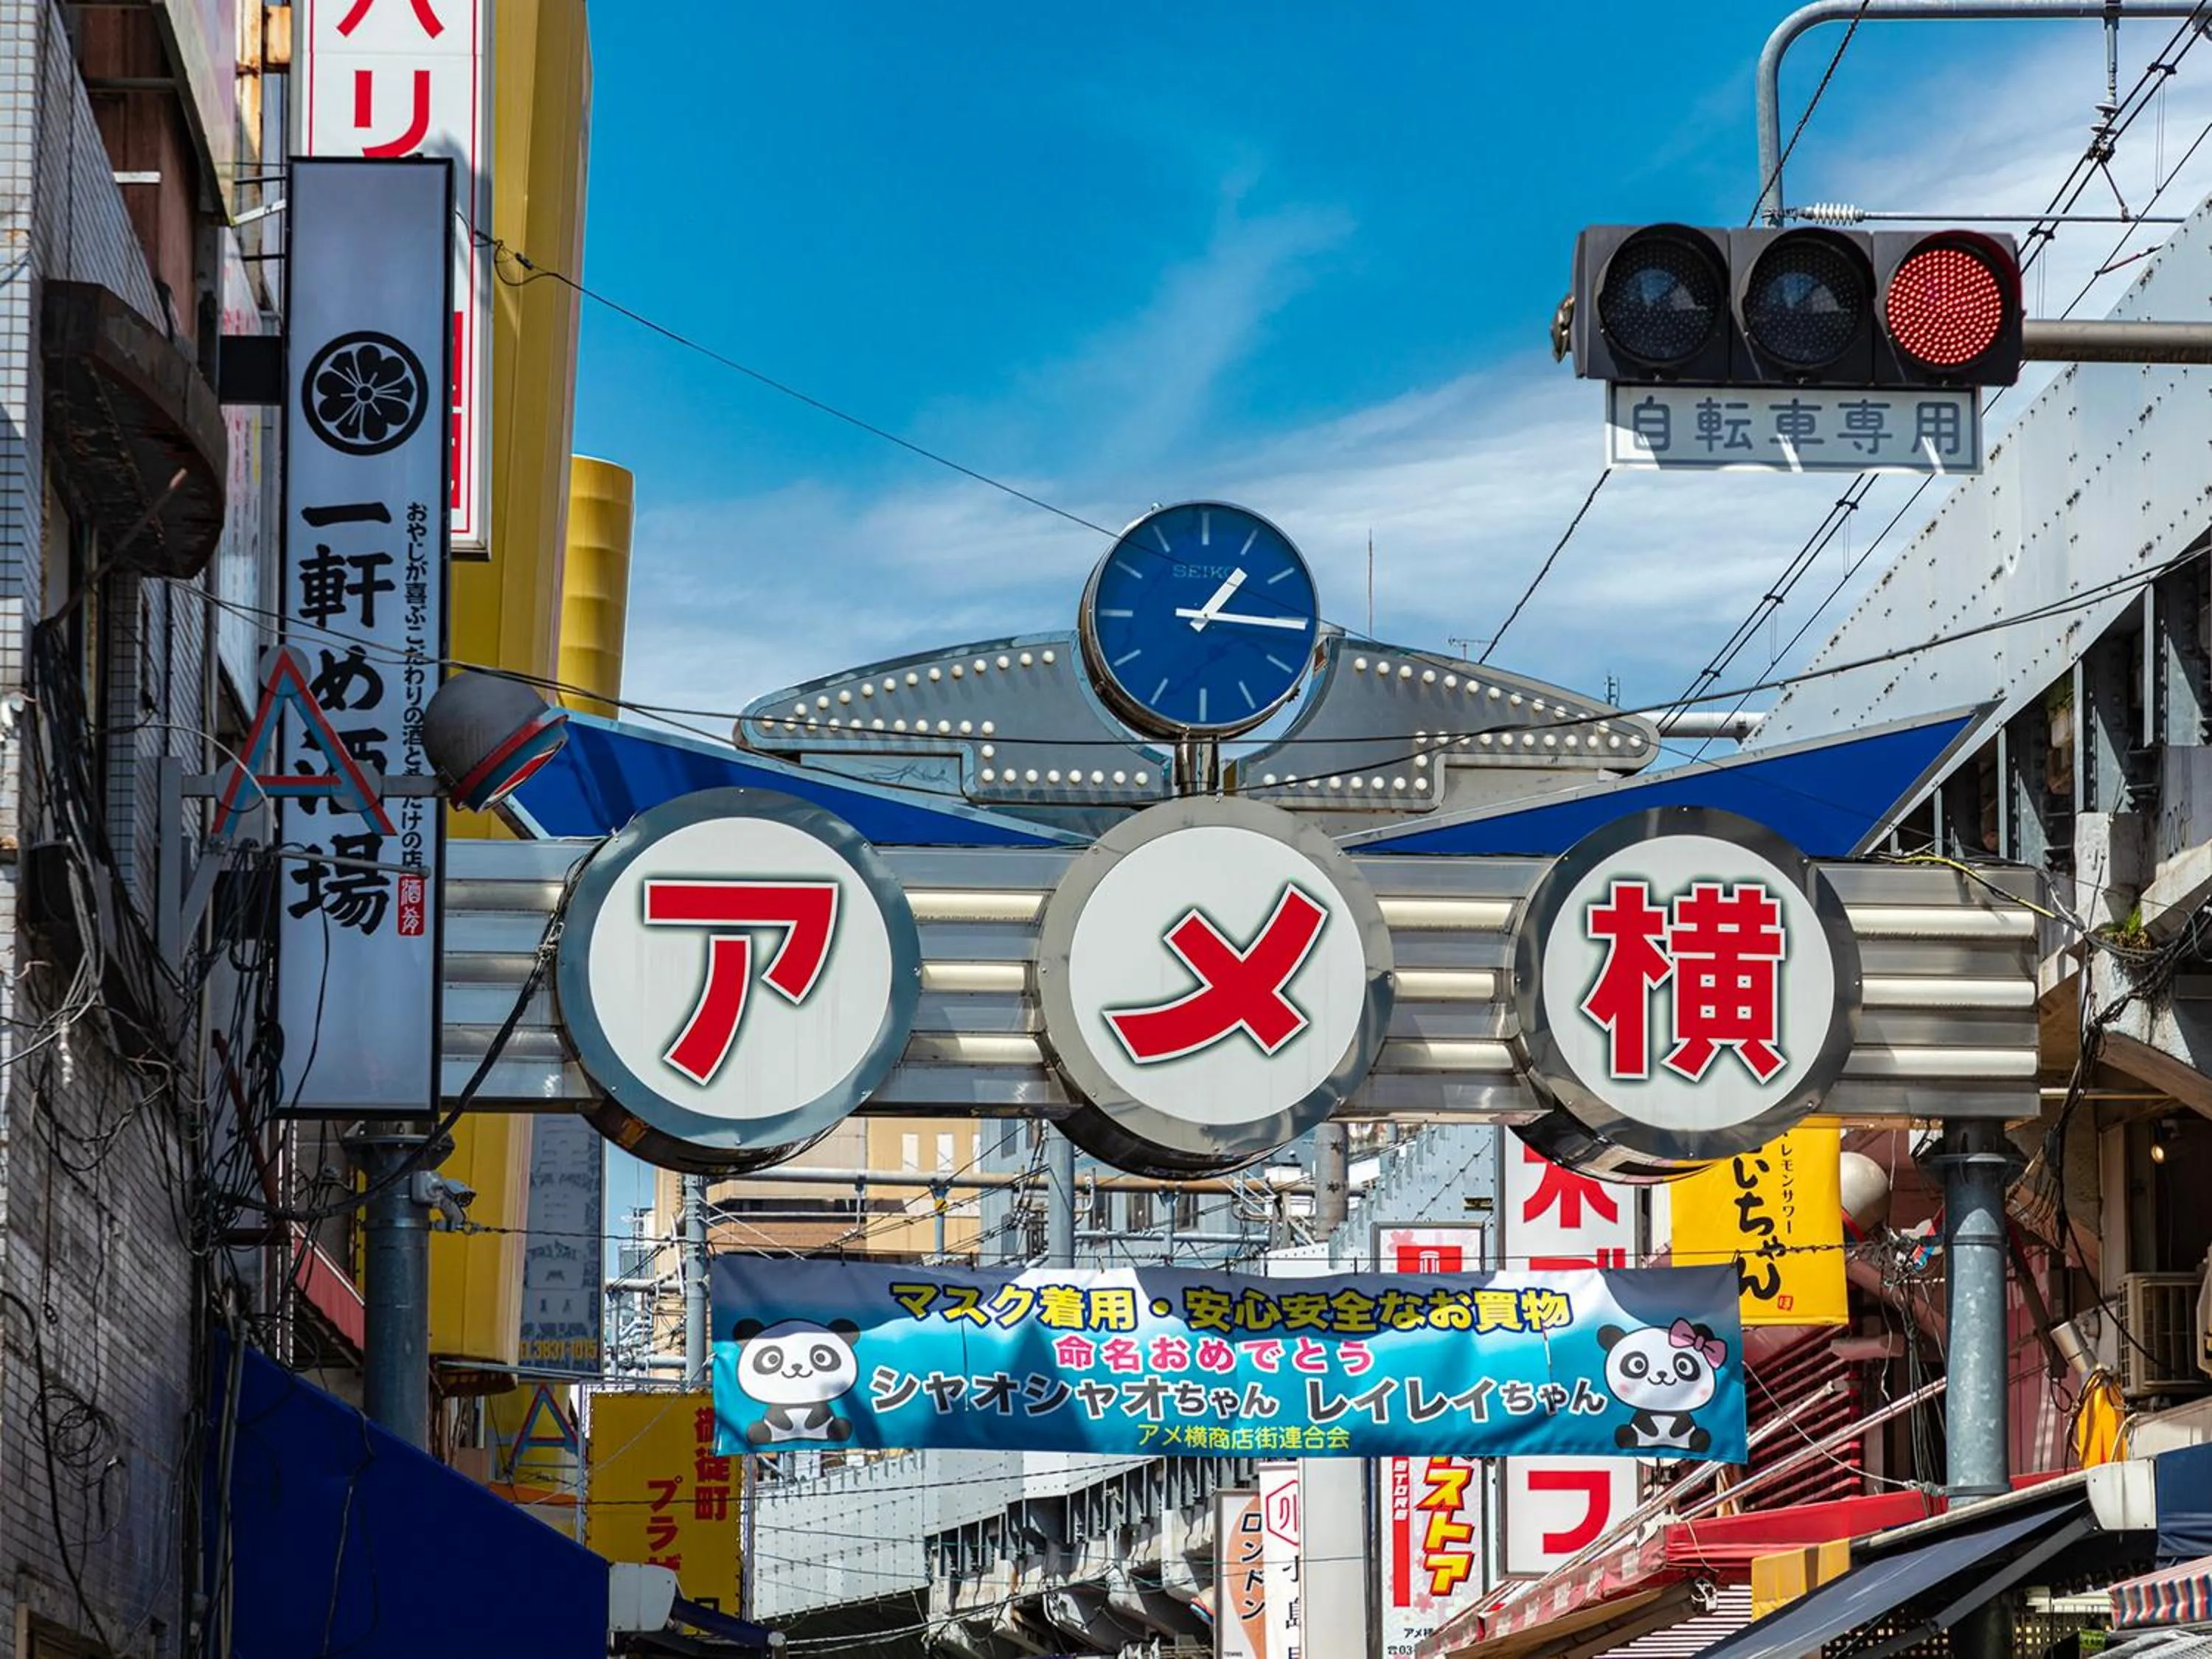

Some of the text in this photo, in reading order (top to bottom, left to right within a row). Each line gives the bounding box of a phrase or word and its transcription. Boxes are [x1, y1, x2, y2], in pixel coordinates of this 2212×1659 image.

[1632, 395, 1961, 456] 自転車専用
[402, 501, 428, 872] おやじが喜ぶこだわりの酒とけの店
[643, 877, 1788, 1087] アメ横
[1733, 1147, 1787, 1300] いちゃん
[889, 1281, 1574, 1333] マスク着用・安心安全なお買物
[869, 1364, 1607, 1424] シャオシャオちゃん レイレイちゃん
[1056, 1334, 1374, 1375] 命名おめでとう
[1136, 1424, 1351, 1452] アメ横商店街連合会
[1241, 1514, 1265, 1620] ロンドン
[1415, 1457, 1475, 1596] ストア
